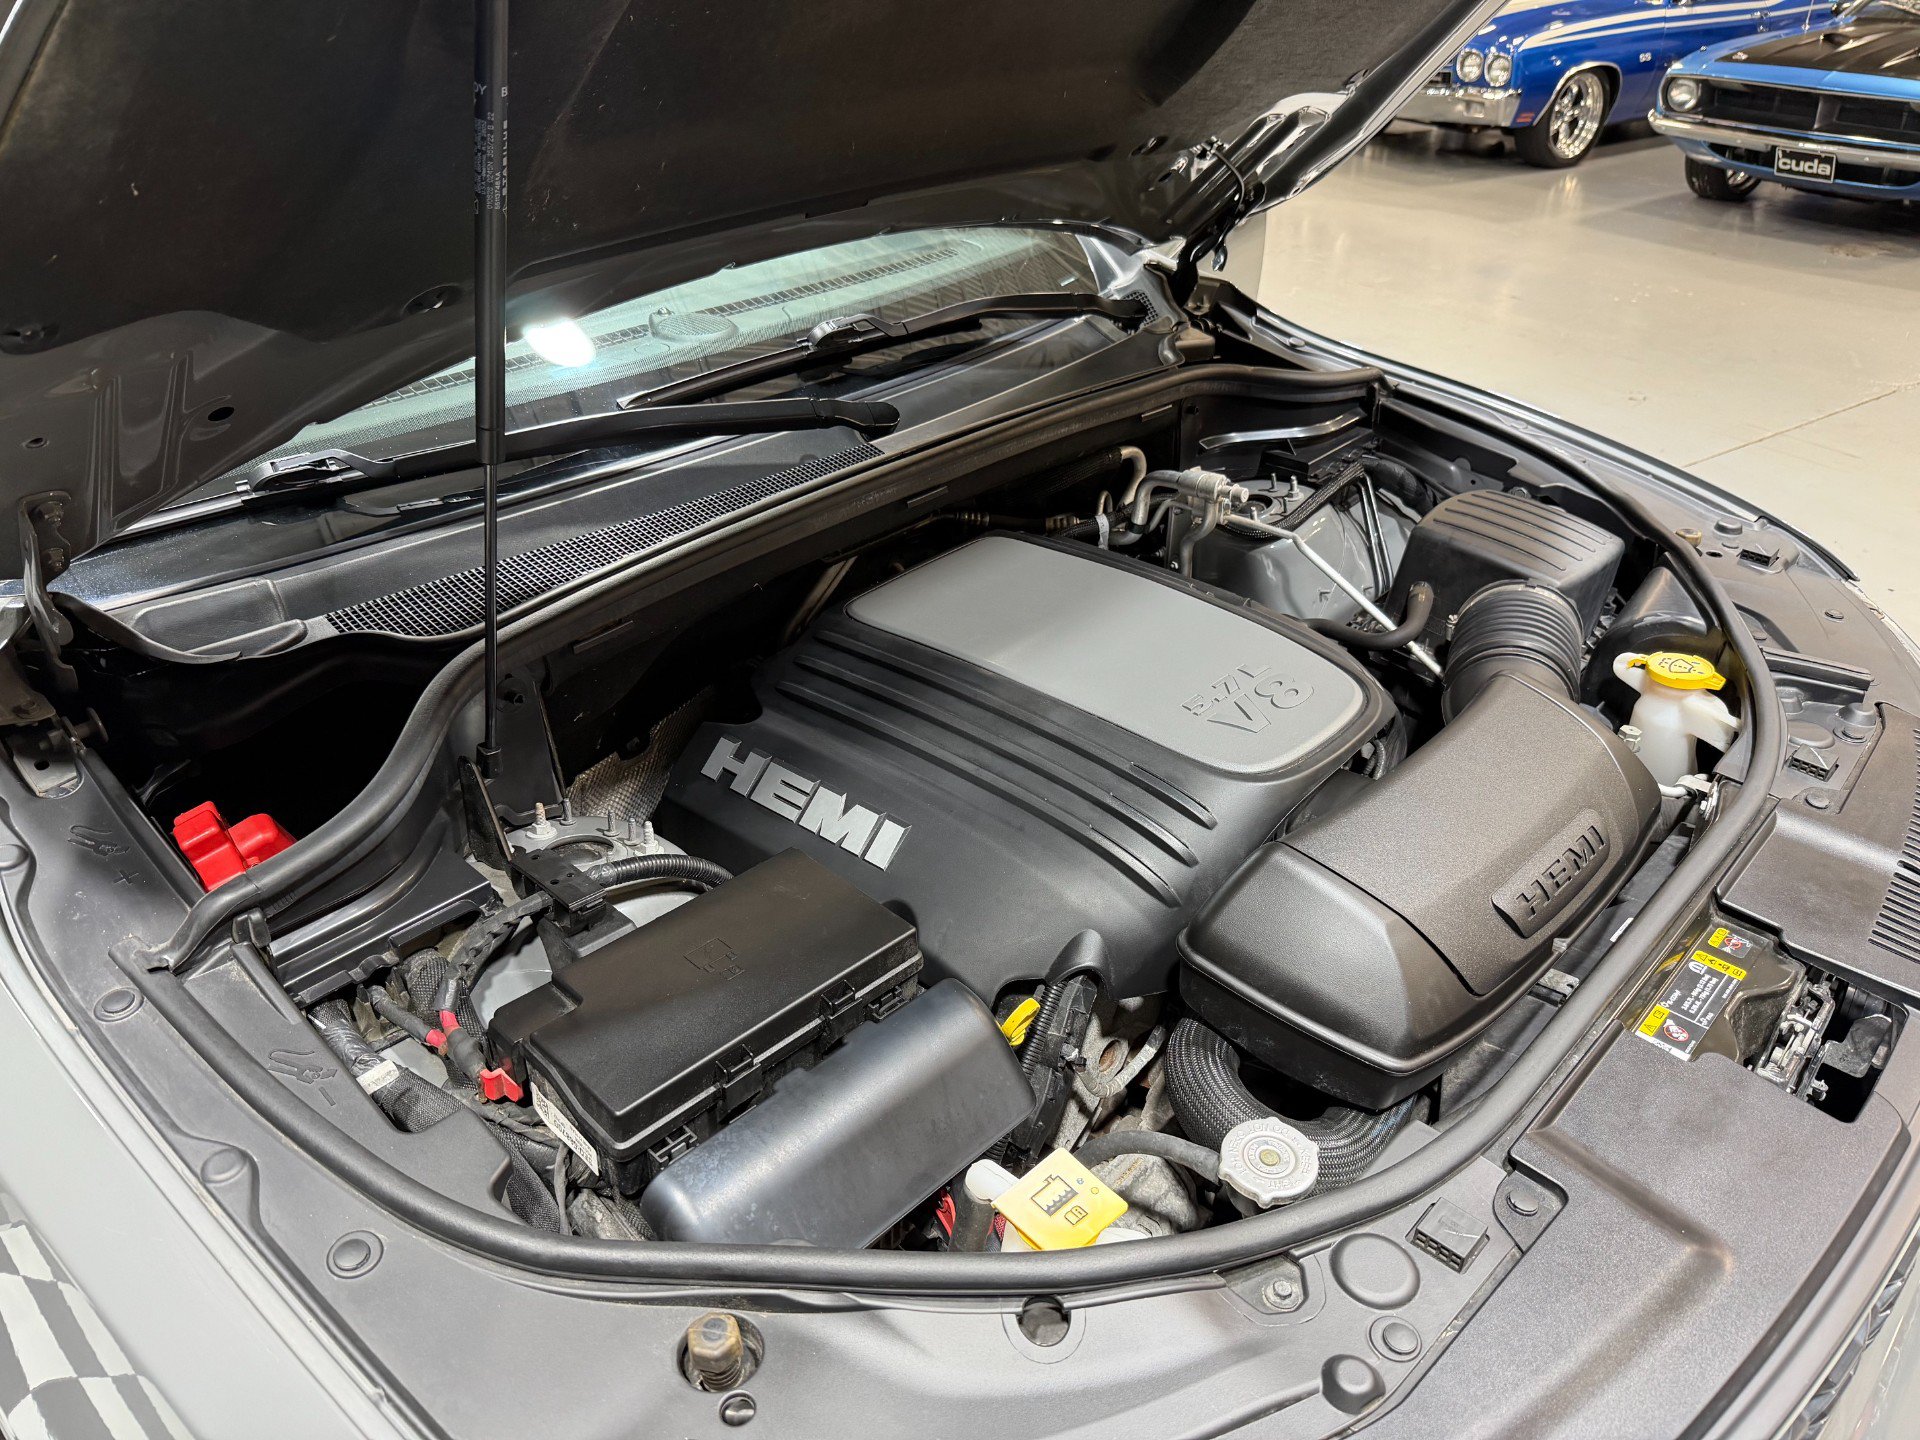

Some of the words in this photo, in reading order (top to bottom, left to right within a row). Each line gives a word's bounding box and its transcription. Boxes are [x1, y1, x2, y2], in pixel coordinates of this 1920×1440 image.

[1181, 663, 1272, 716] 5.7L
[1206, 673, 1315, 734] V8
[700, 735, 912, 872] HEMI
[1515, 824, 1606, 921] HEMI
